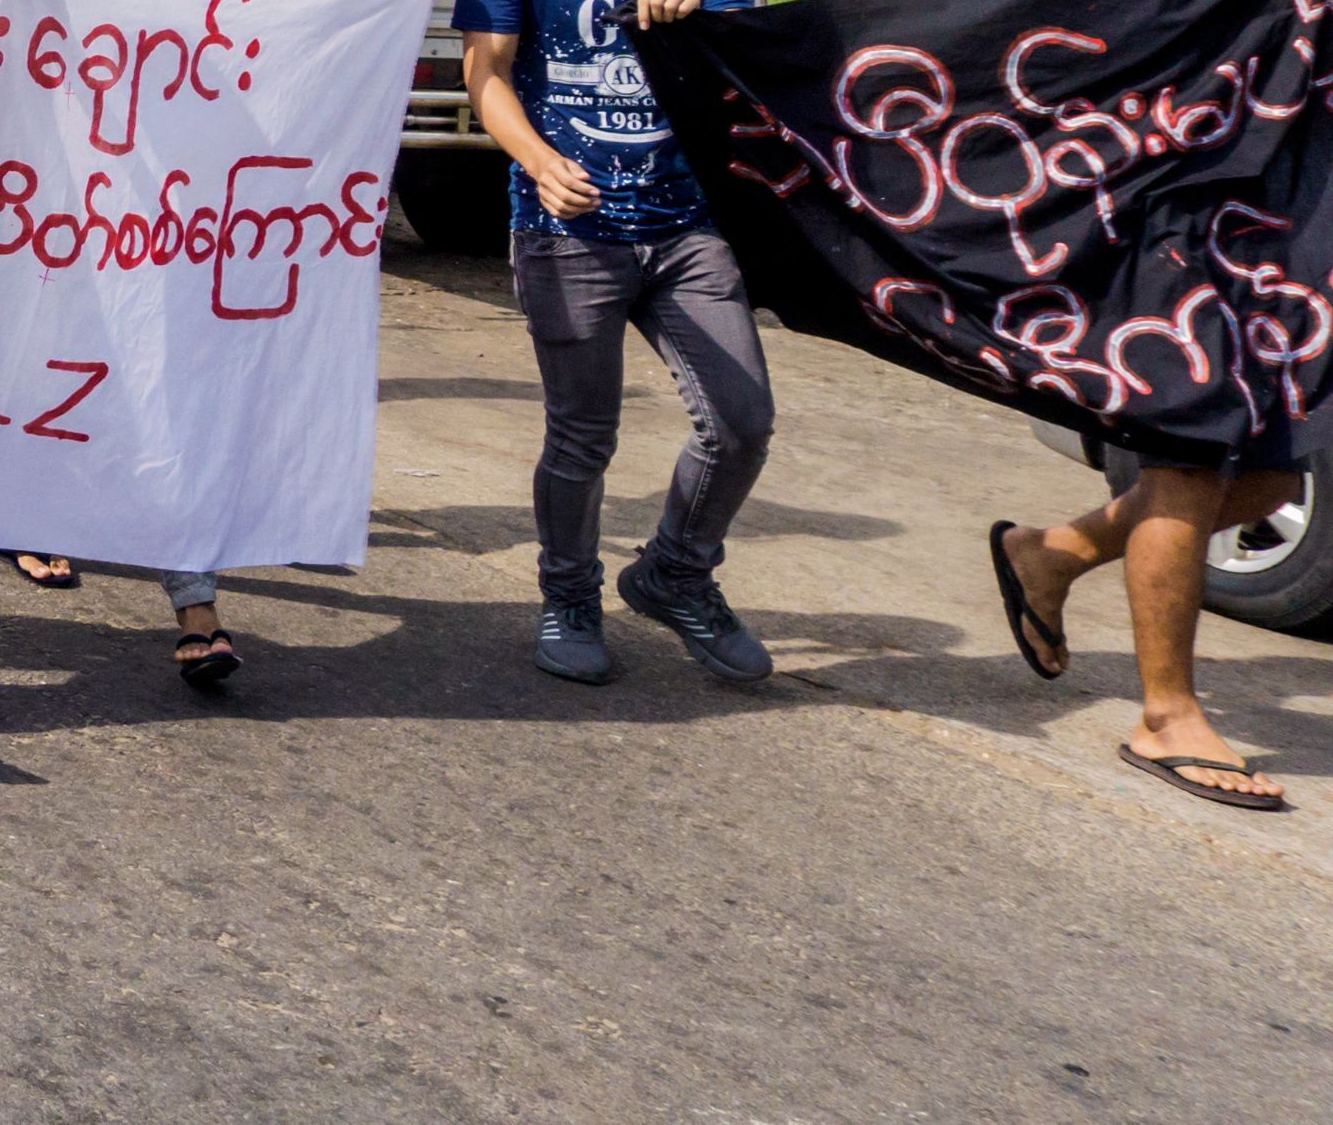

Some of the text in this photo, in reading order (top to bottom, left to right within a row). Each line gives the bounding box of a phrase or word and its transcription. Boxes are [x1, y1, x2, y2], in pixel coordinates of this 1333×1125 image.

[547, 94, 594, 106] ARMAN
[597, 96, 639, 107] JEANS
[597, 111, 657, 131] 1981
